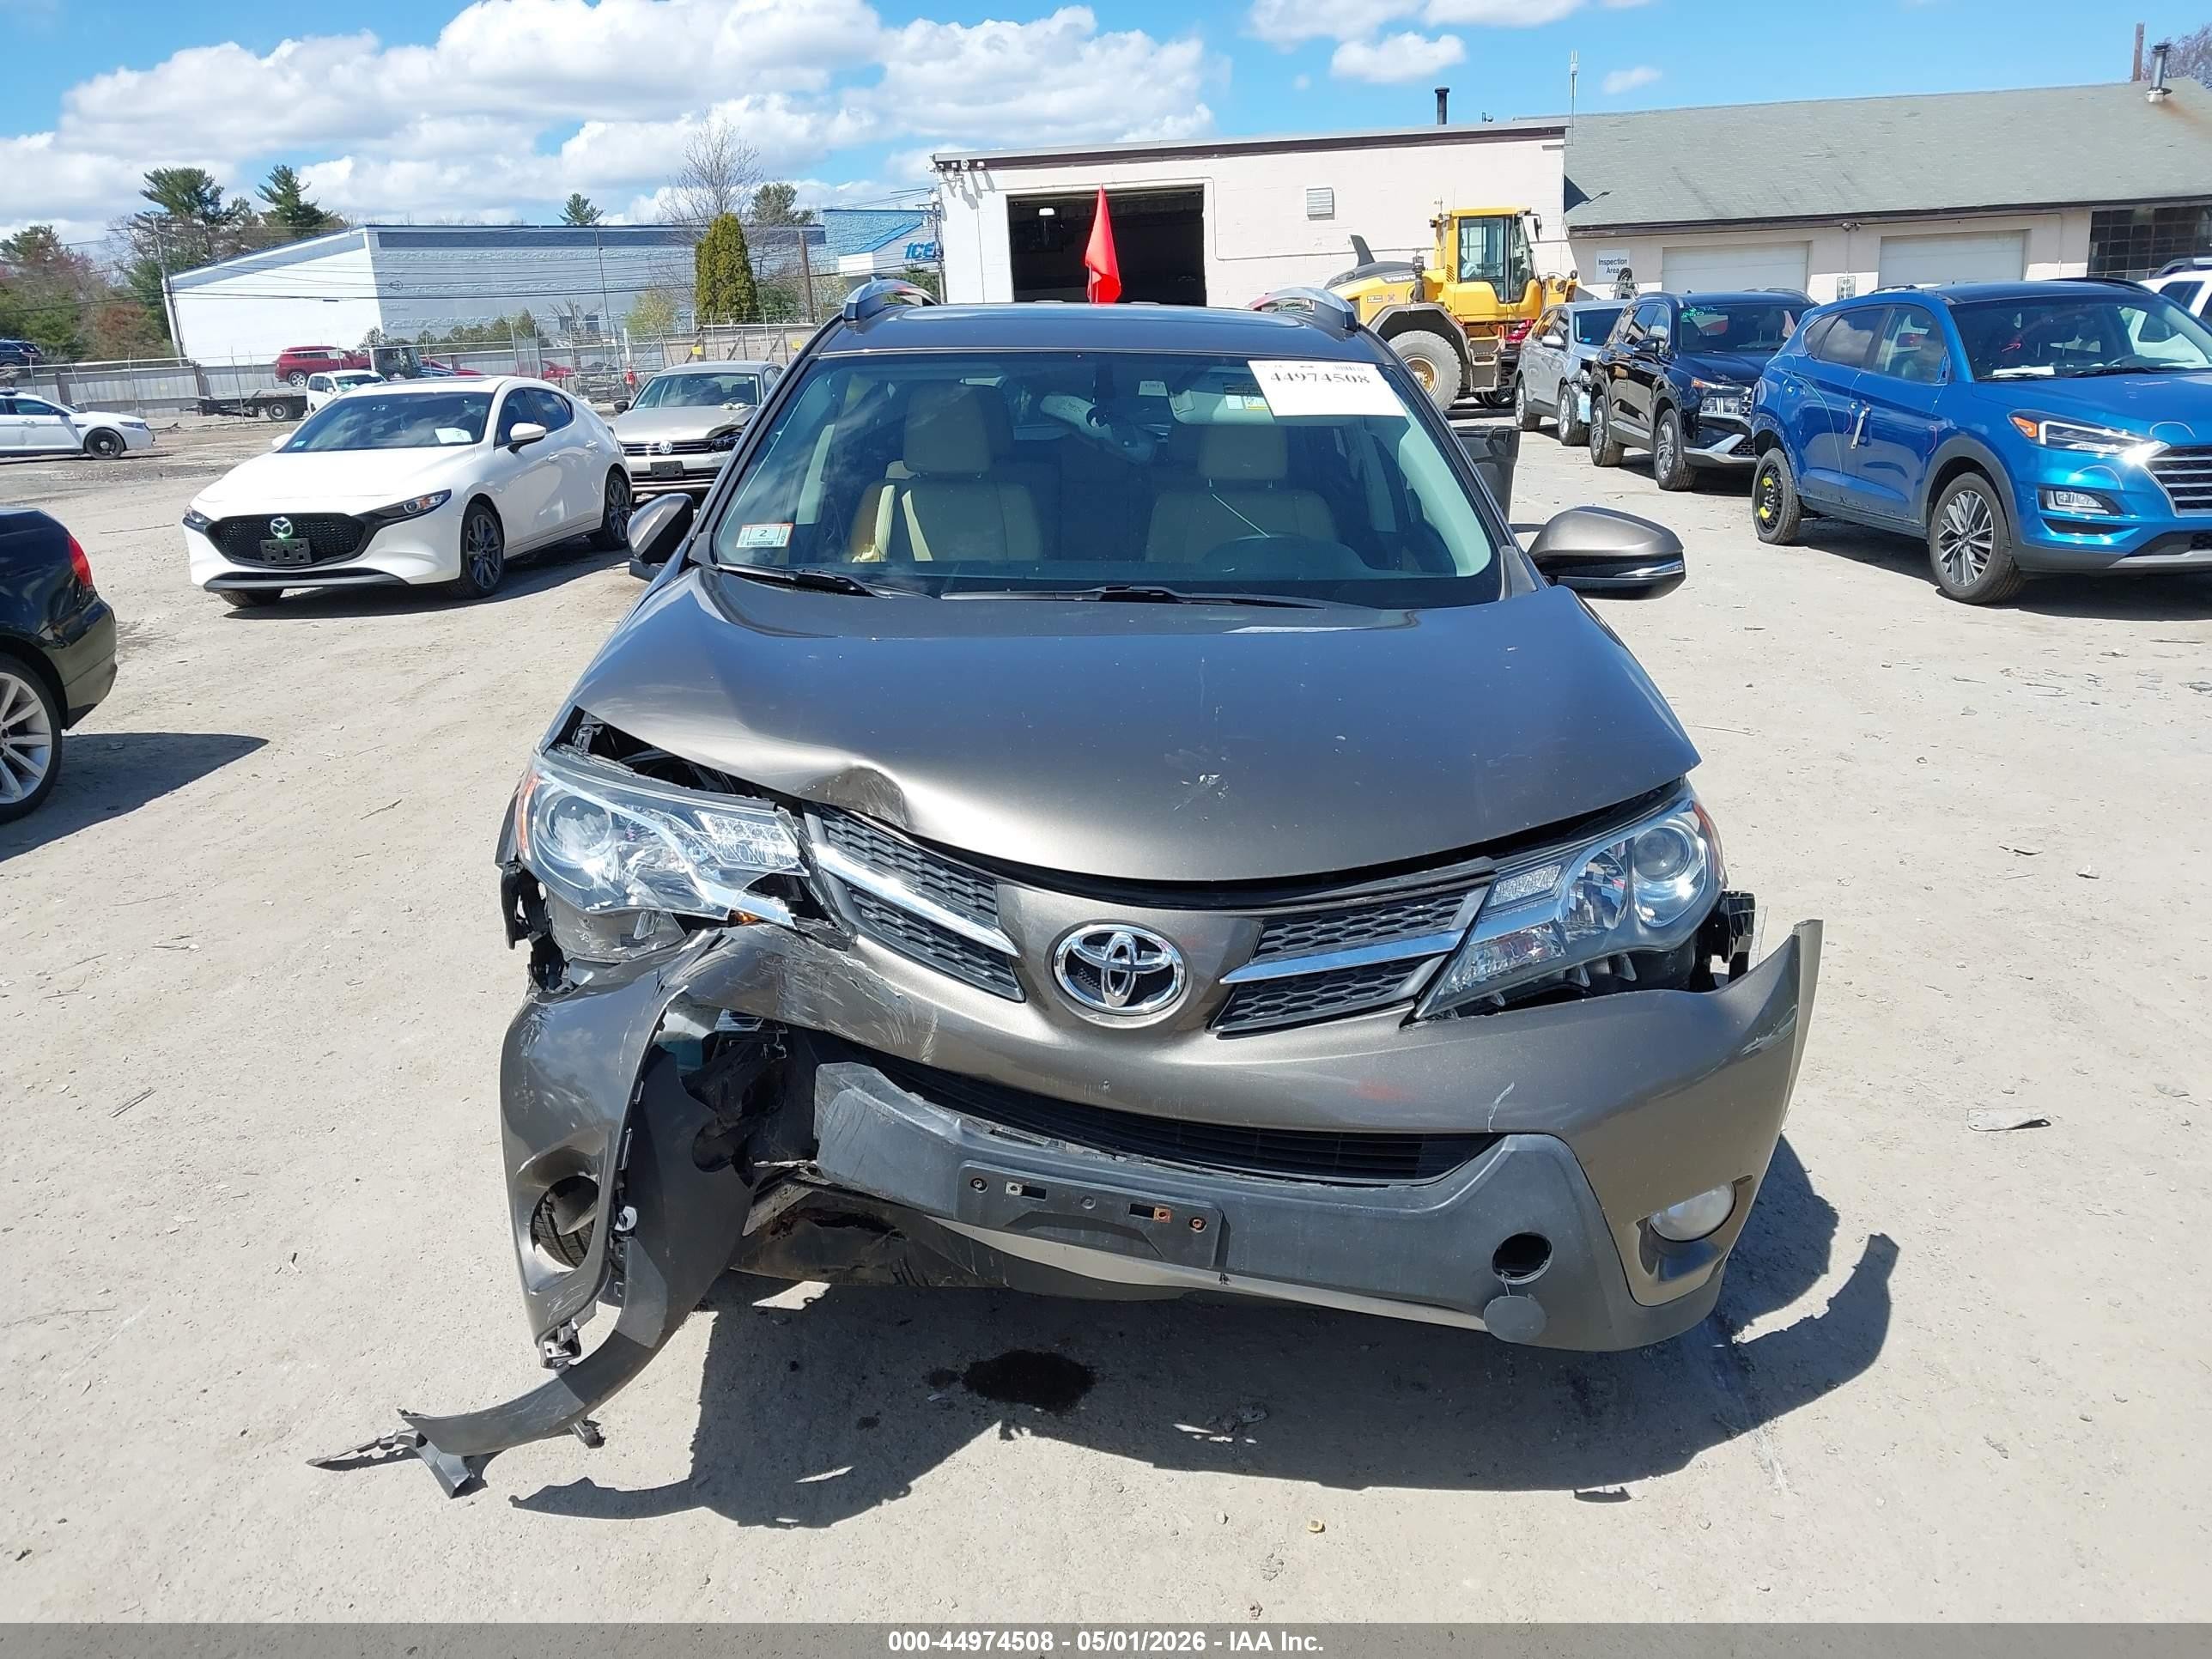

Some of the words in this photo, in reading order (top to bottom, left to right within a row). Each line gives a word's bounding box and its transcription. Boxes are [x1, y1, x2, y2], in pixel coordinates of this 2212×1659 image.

[1598, 258, 1628, 267] Inspection
[1270, 372, 1370, 384] 44974508
[759, 529, 769, 538] 2
